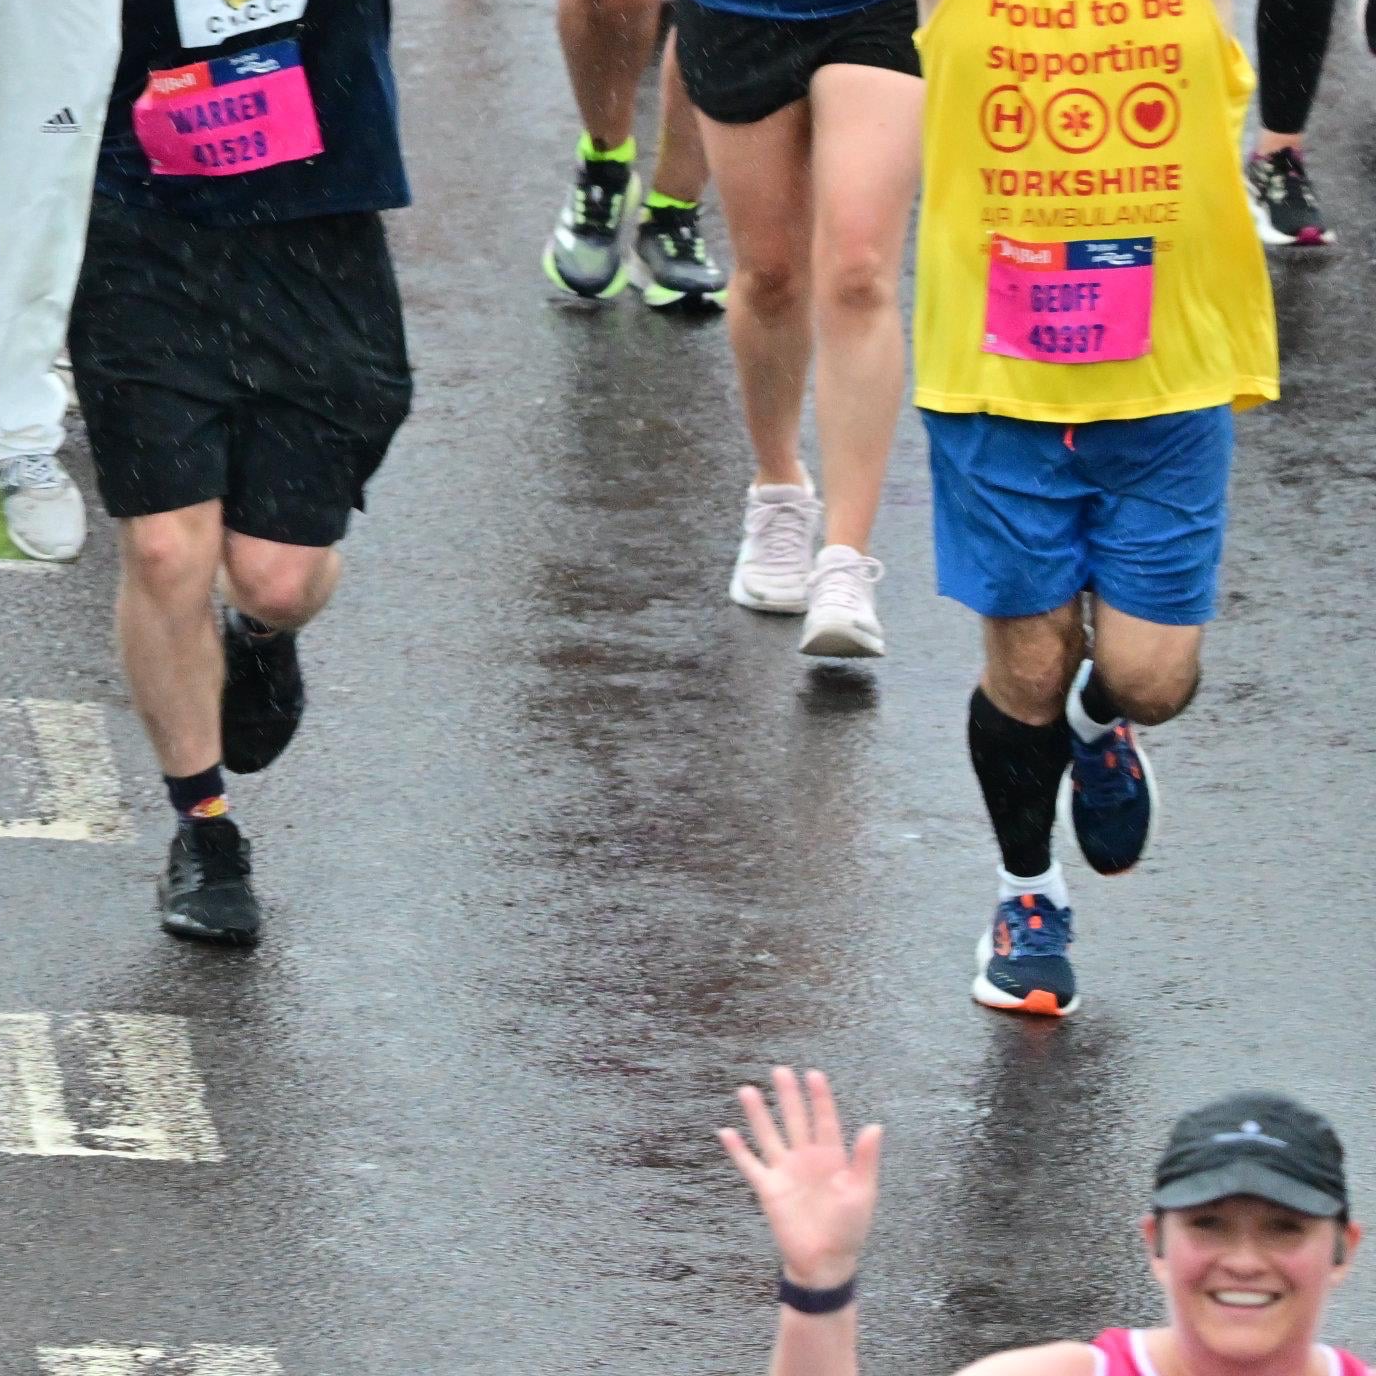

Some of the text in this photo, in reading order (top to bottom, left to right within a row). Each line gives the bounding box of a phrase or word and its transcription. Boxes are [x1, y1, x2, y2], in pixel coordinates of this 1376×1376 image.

[1091, 0, 1129, 26] to
[168, 90, 268, 135] WARREN
[980, 164, 1183, 197] YORKSHIRE
[1021, 201, 1181, 227] AMBULANCE
[1030, 283, 1101, 313] GEOFF
